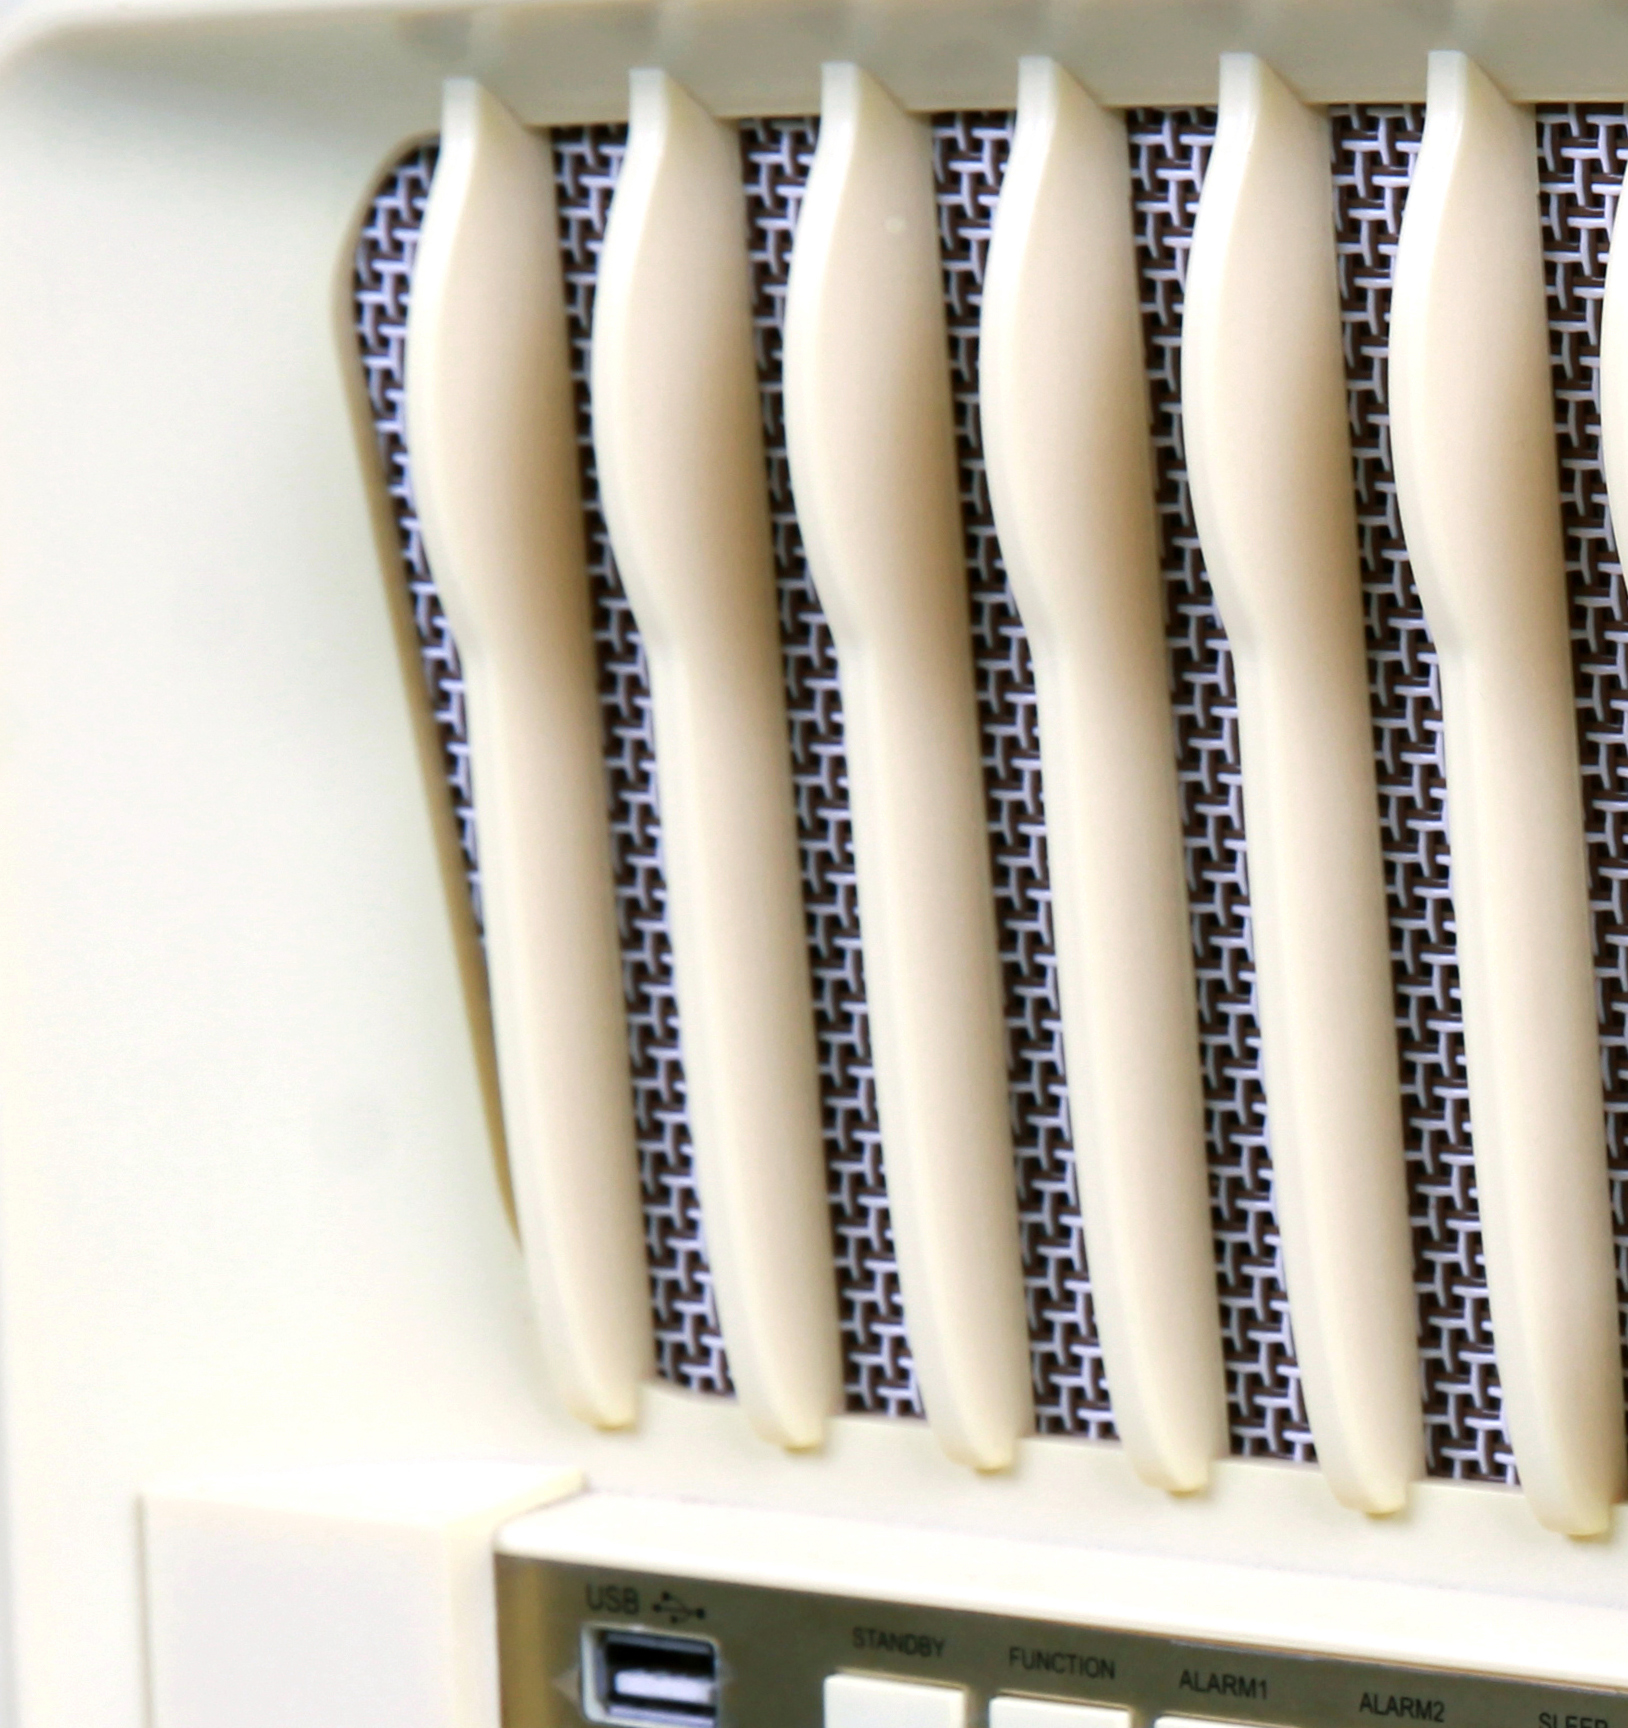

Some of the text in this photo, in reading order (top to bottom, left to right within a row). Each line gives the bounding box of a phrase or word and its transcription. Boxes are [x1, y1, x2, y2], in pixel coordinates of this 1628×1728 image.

[584, 1582, 640, 1614] USB
[851, 1625, 945, 1659] STANDBY
[1007, 1645, 1117, 1681] FUNCTION
[1178, 1669, 1269, 1700] ALARM1
[1359, 1692, 1446, 1724] ALARM2
